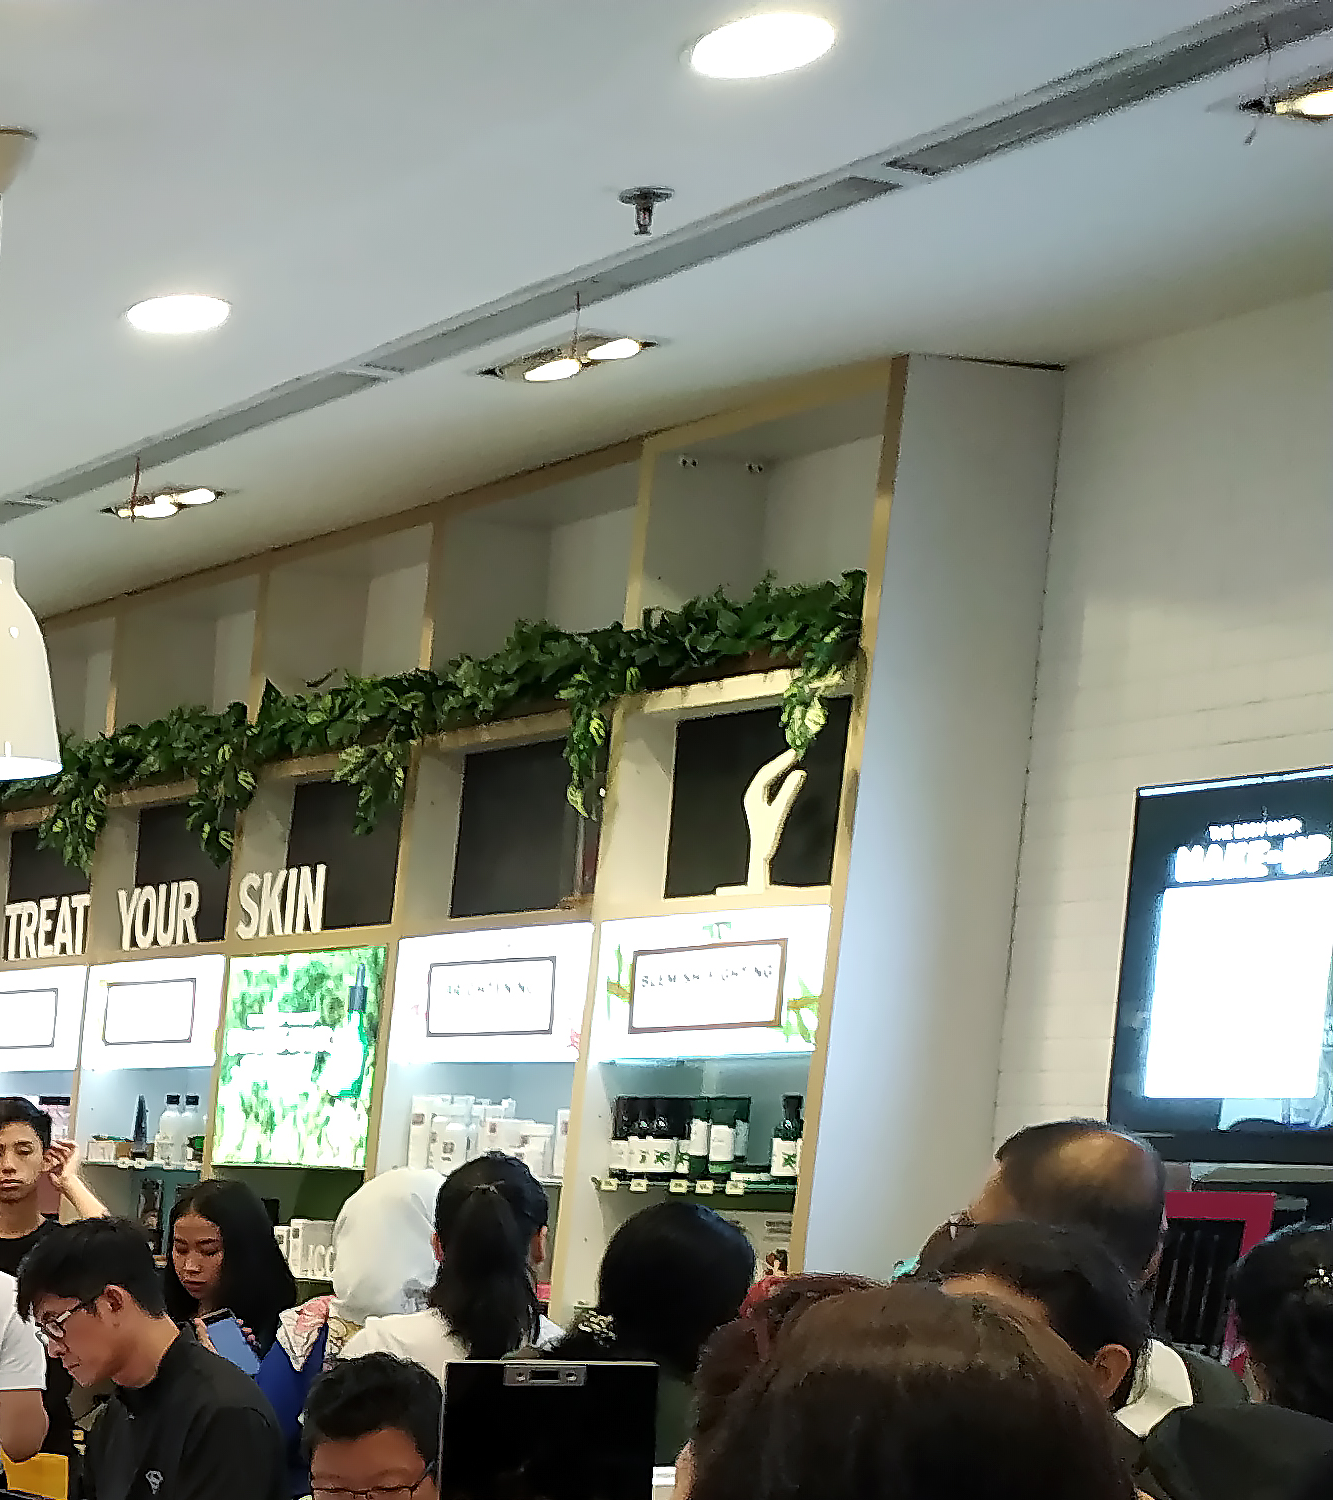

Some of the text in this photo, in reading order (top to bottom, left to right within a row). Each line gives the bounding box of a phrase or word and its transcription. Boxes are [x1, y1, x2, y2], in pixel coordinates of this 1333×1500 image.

[3, 863, 328, 962] TREAT YOUR SKIN
